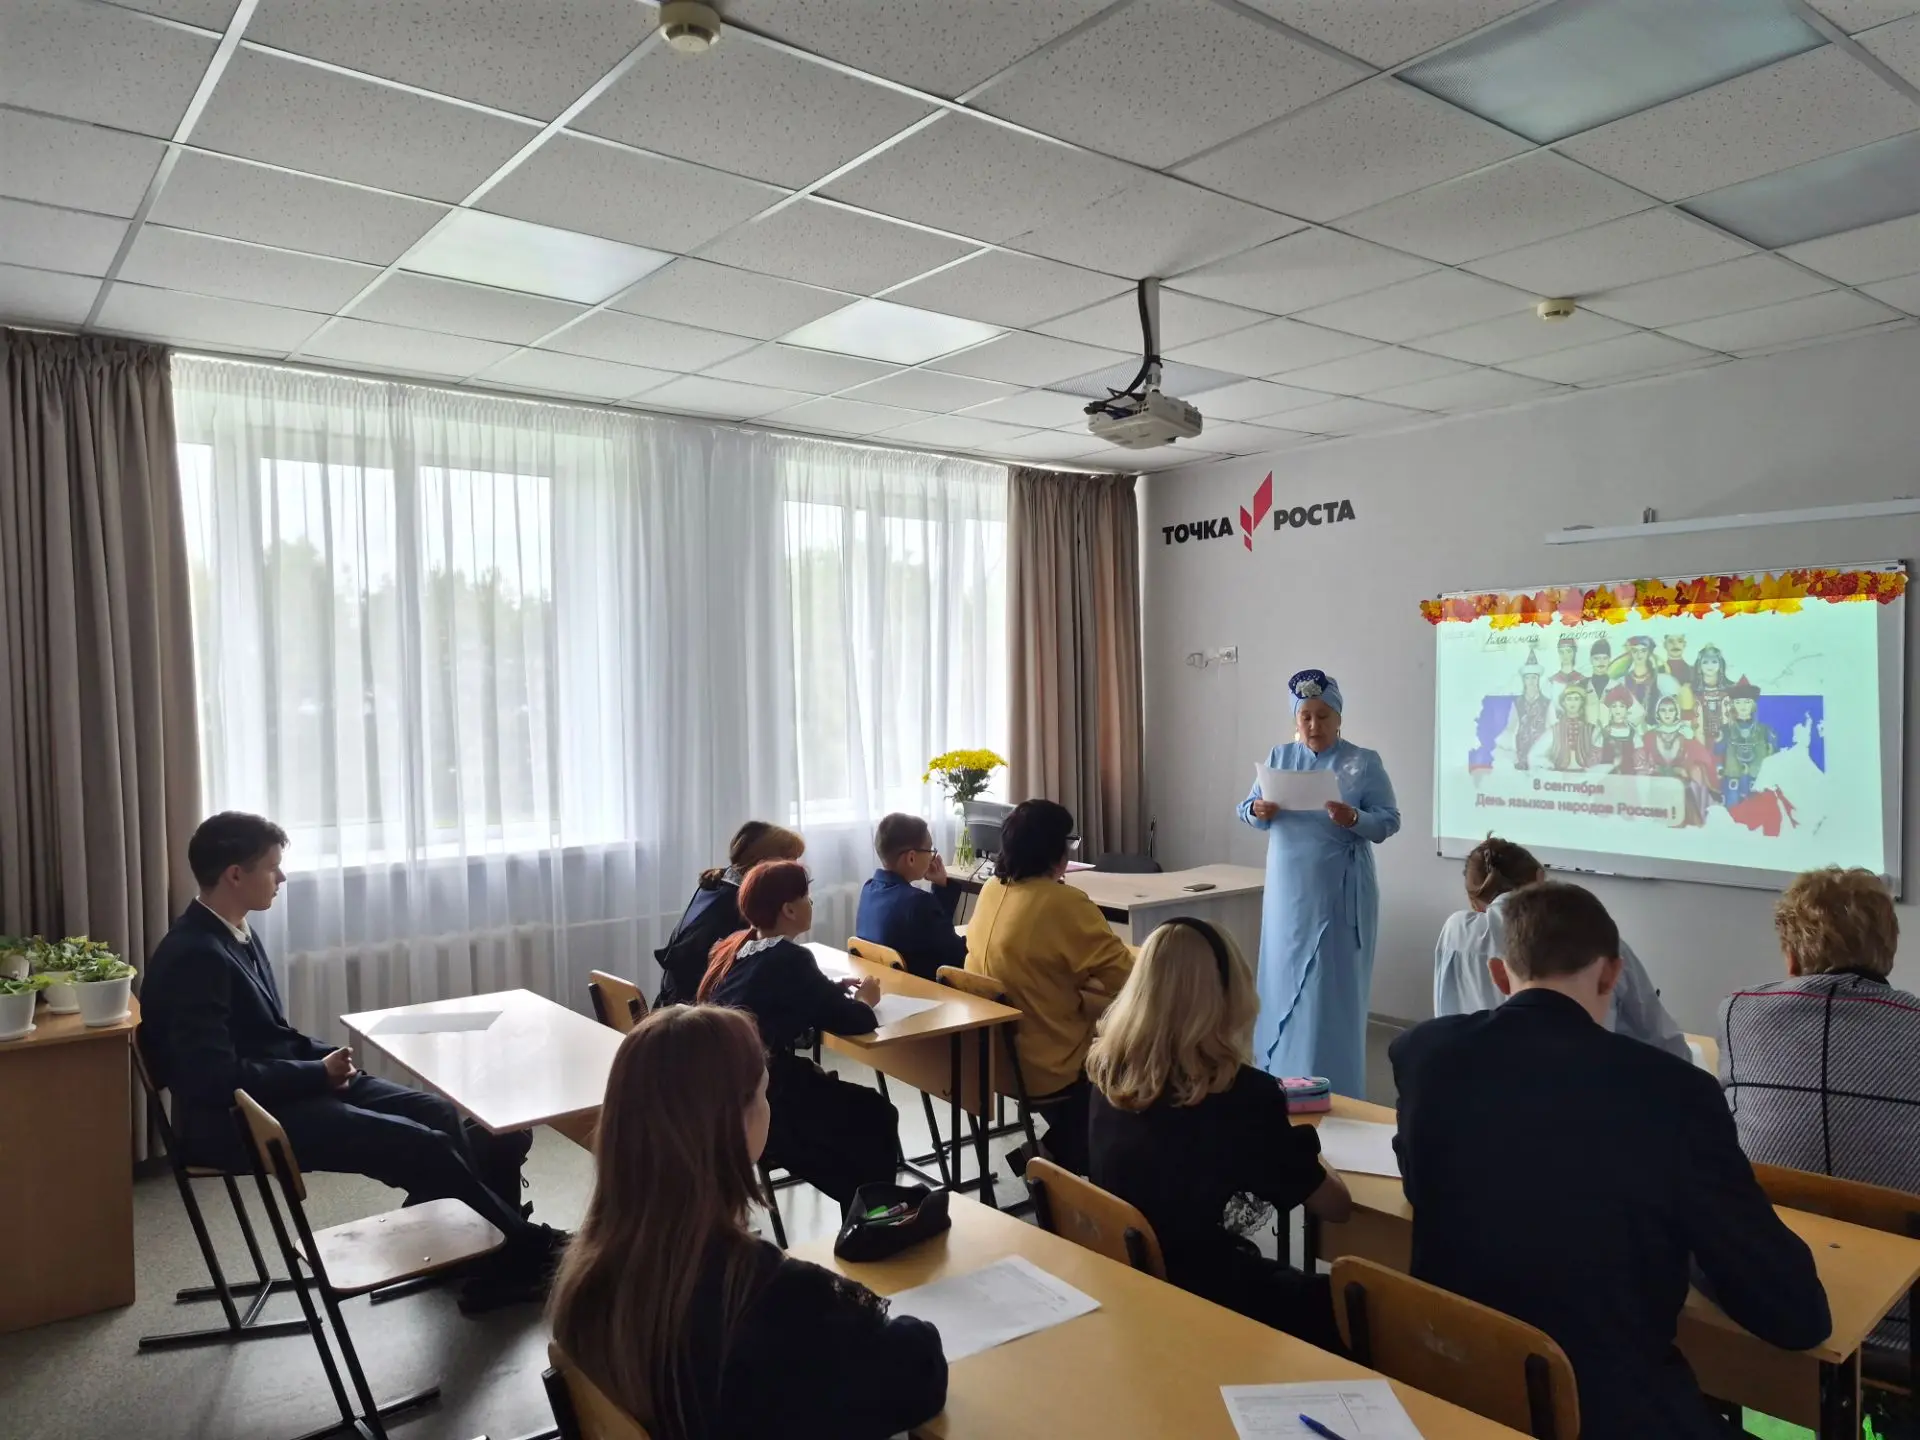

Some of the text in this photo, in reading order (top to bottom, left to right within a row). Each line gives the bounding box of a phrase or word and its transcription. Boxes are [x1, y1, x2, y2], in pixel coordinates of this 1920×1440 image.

[1162, 499, 1356, 545] ТОЧКА РОСТА
[1543, 781, 1605, 797] сентября
[1475, 793, 1506, 808] День
[1508, 798, 1555, 810] языков
[1557, 801, 1614, 816] народов
